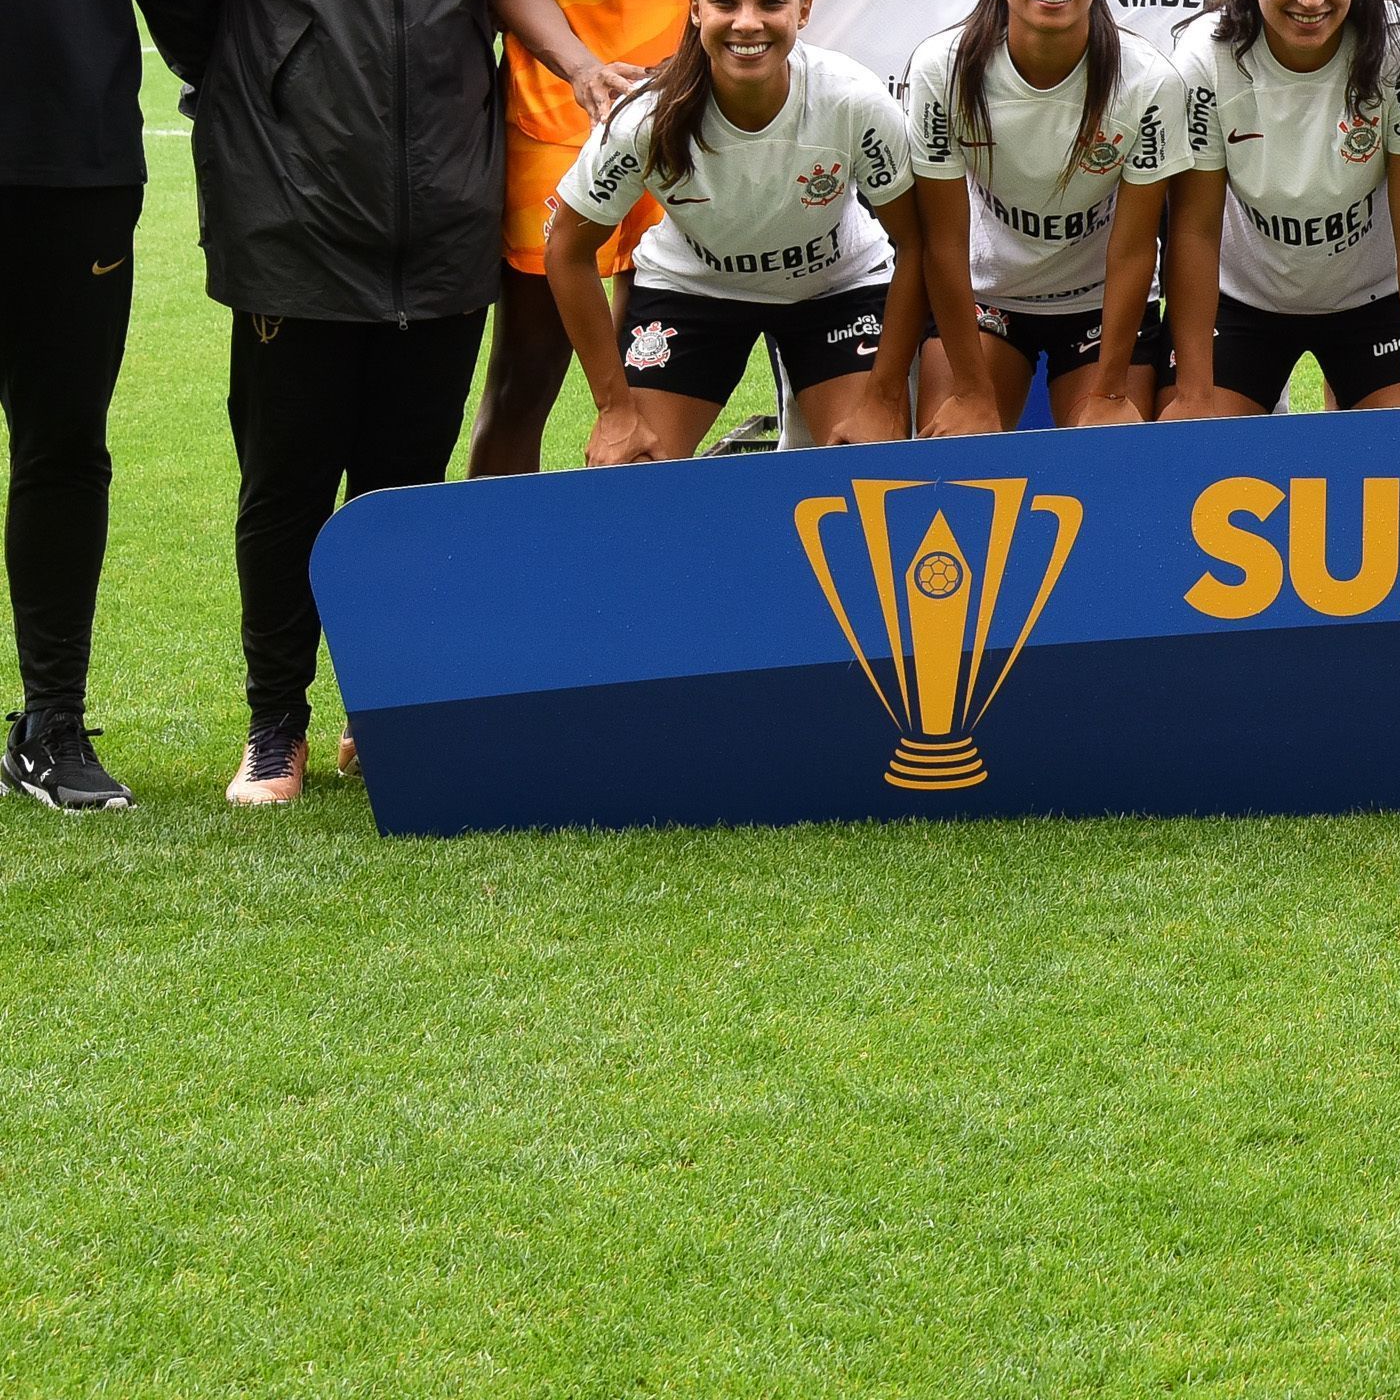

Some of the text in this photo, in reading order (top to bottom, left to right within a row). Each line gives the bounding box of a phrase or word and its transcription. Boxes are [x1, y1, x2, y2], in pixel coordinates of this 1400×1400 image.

[1190, 85, 1217, 137] bmg
[867, 140, 893, 189] bmg
[1132, 119, 1160, 169] bmg
[603, 152, 642, 194] bmg
[1327, 220, 1374, 257] .COM
[785, 252, 842, 281] .COM
[827, 321, 884, 344] UniCes
